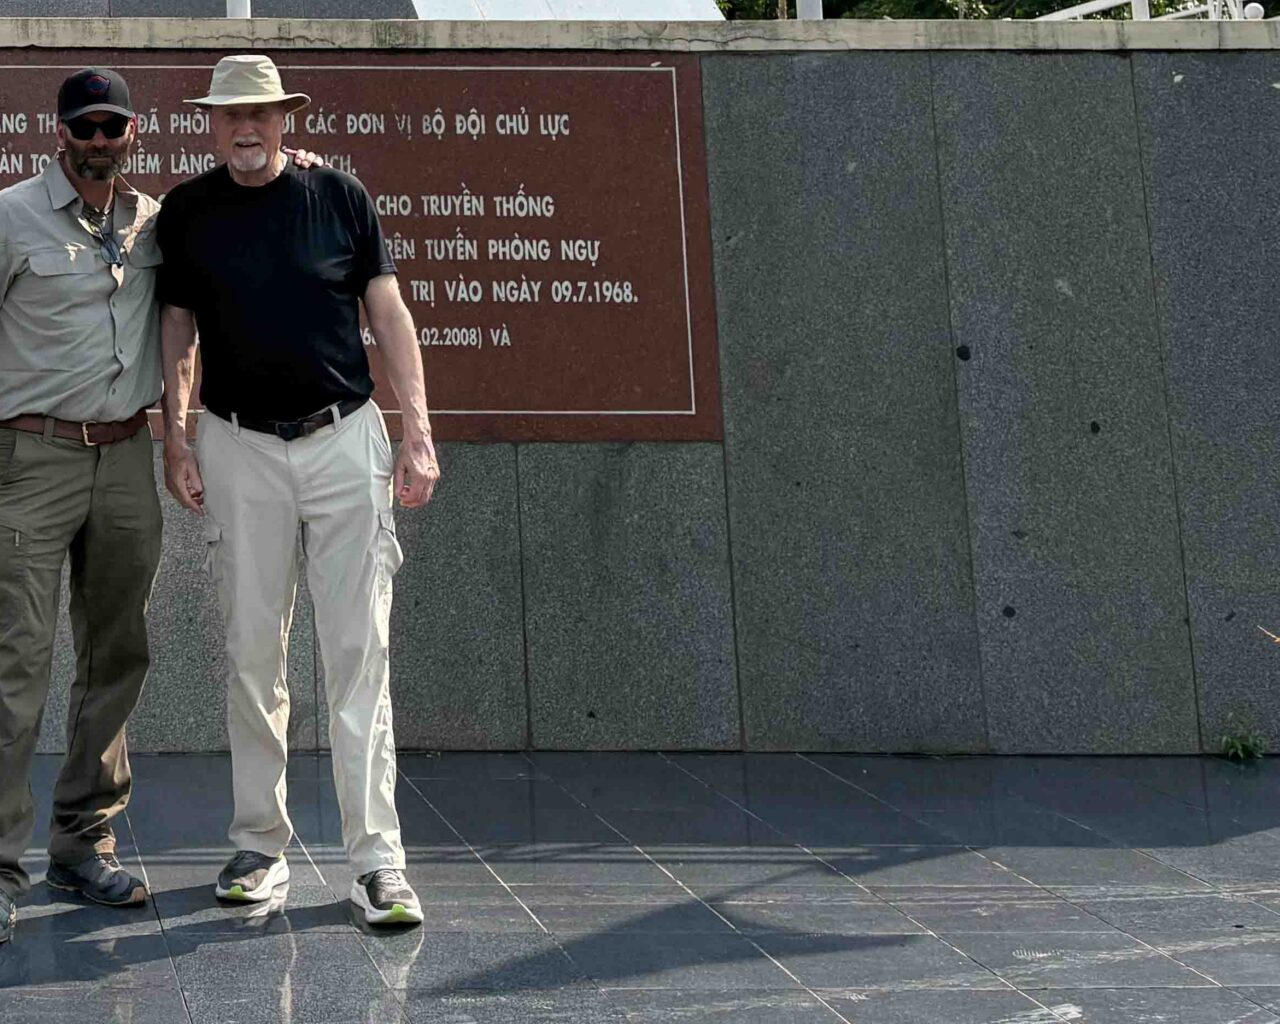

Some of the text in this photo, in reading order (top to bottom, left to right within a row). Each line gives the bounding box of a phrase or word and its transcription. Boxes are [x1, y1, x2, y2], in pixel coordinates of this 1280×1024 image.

[136, 106, 161, 135] ĐÃ
[305, 106, 338, 135] CÁC
[346, 113, 385, 135] ĐƠN
[421, 106, 446, 140] BỘ
[454, 106, 486, 140] ĐỘI
[495, 106, 530, 135] CHỦ
[539, 113, 570, 140] LỰC
[170, 146, 217, 175] LÀNG
[375, 195, 413, 217] CHO
[420, 182, 485, 217] TRUYỀN
[493, 182, 556, 217] THỐNG
[425, 225, 478, 260] TUYẾN
[487, 232, 551, 261] PHÒNG
[560, 239, 601, 265] NGỰ
[410, 280, 436, 306] TRỊ
[444, 273, 483, 302] VÀO
[492, 273, 543, 302] NGÀY
[551, 280, 639, 302] 09.7.1968.
[490, 321, 511, 347] VÀ
